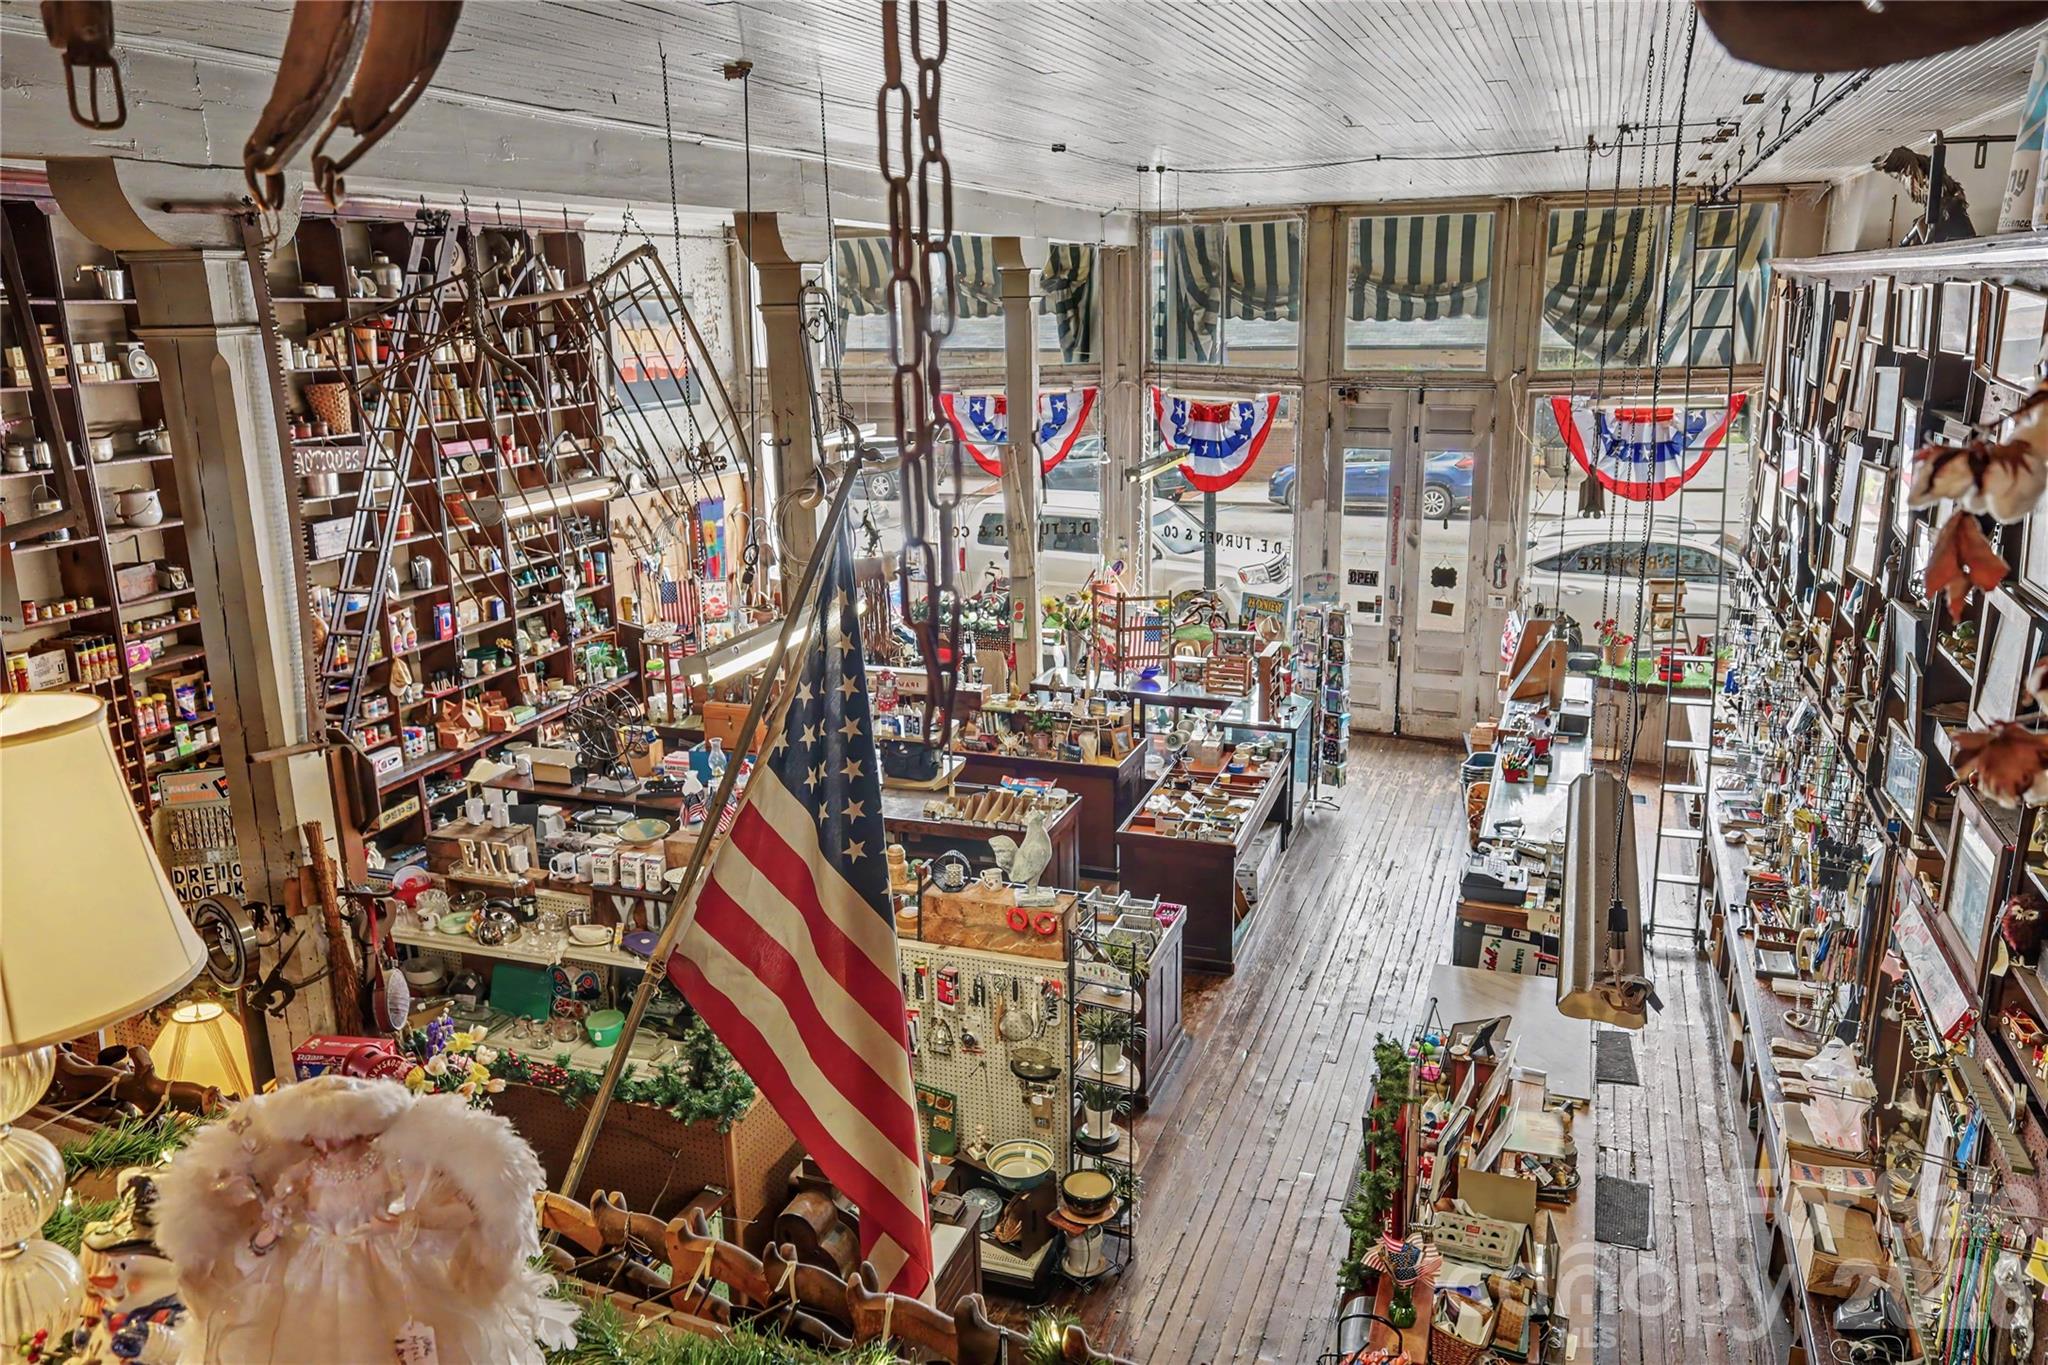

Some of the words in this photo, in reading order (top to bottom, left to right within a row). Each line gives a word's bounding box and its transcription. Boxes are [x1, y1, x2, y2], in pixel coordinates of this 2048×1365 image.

[294, 449, 360, 475] ANTIQUES
[1349, 571, 1377, 585] OPEN
[458, 838, 512, 880] EAT
